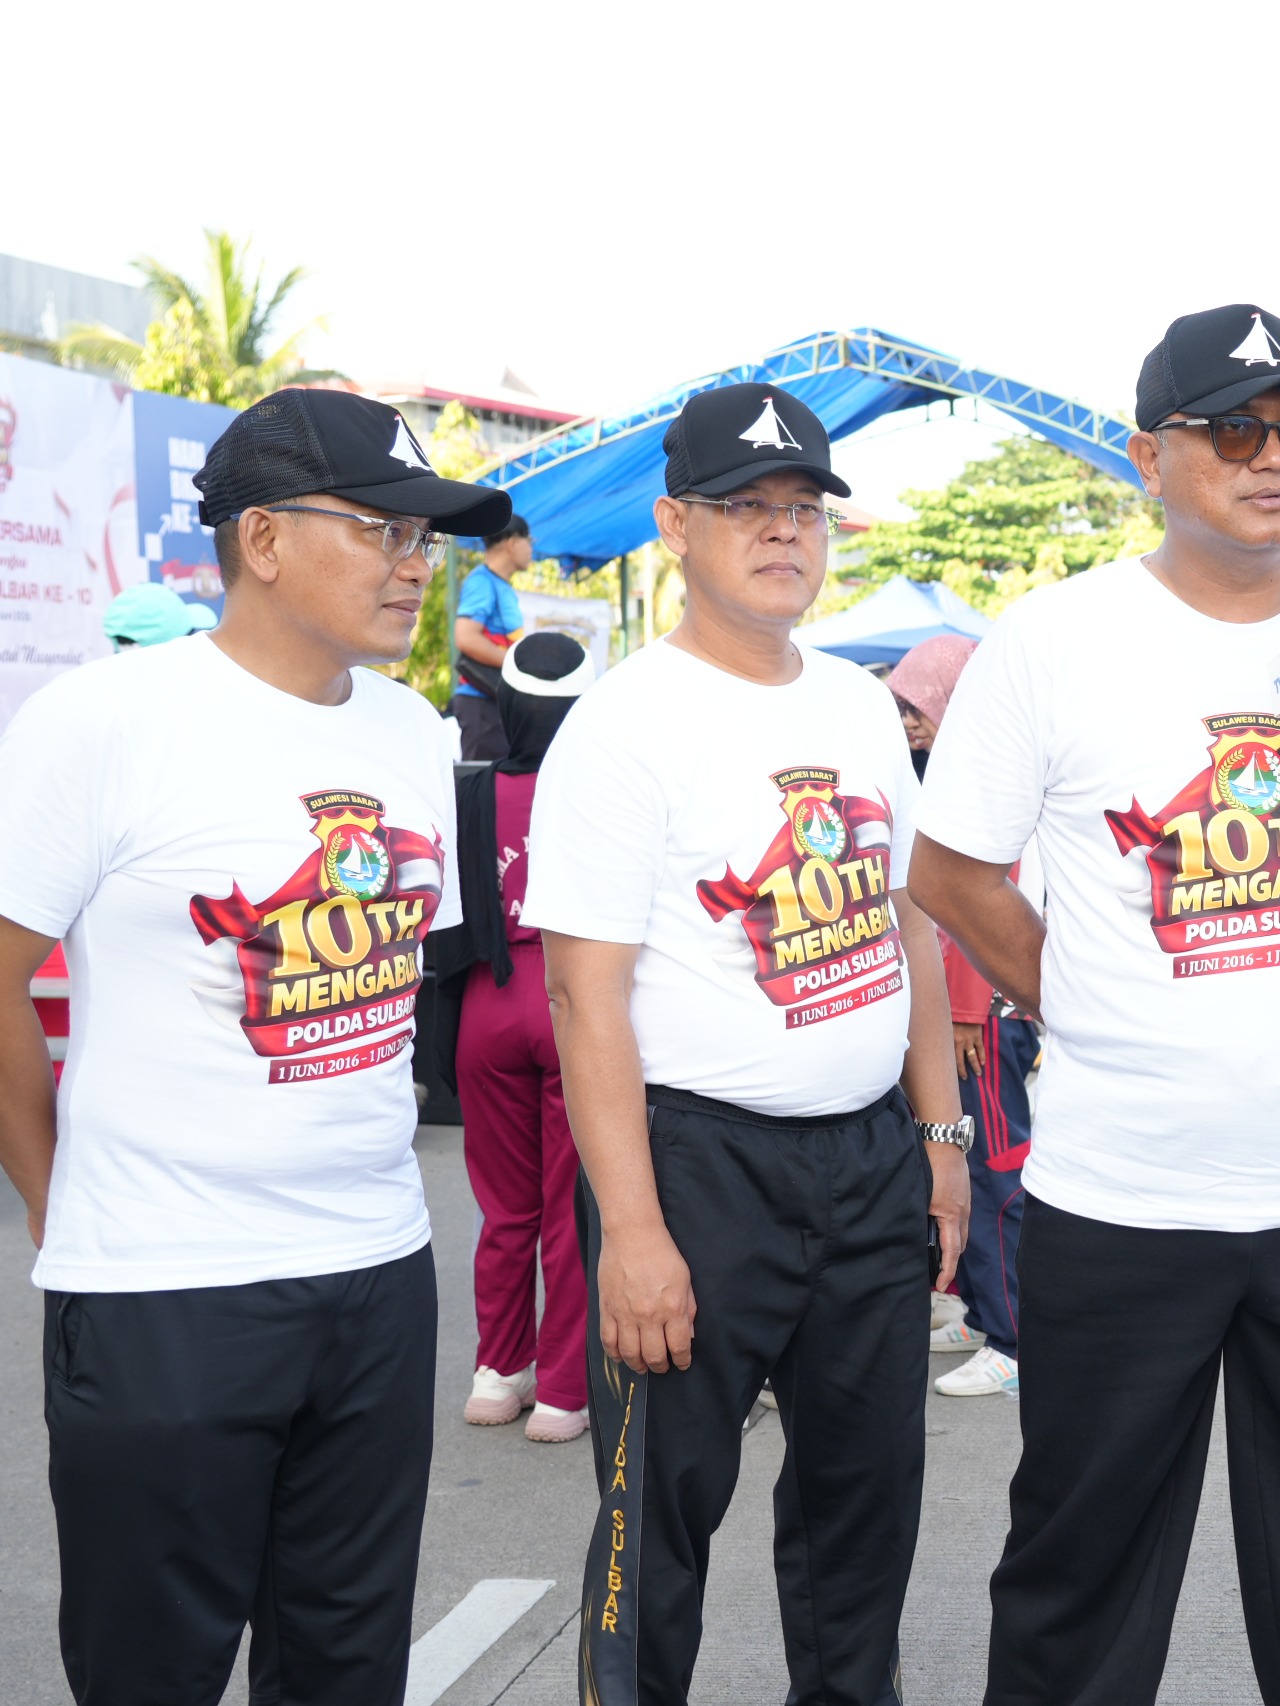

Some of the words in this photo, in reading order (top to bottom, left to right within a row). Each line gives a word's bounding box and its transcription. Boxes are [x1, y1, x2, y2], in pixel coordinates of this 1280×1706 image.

[1211, 715, 1256, 730] SULAWESI
[779, 771, 809, 785] SULAWESI
[810, 770, 833, 782] BARAT
[309, 794, 350, 810] SULAWESI
[351, 794, 378, 809] BARAT
[756, 857, 885, 936] 10TH
[259, 895, 425, 980] 10TH
[1185, 913, 1258, 944] POLDA
[793, 961, 852, 995] POLDA
[851, 940, 897, 975] SULBAR
[1180, 962, 1187, 974] 1
[1188, 957, 1219, 977] JUNI
[1222, 954, 1254, 970] 2016
[1267, 950, 1273, 963] 1
[792, 1012, 799, 1024] 1
[801, 1004, 828, 1025] JUNI
[829, 996, 854, 1014] 2016
[861, 991, 866, 1003] 1
[867, 984, 887, 1003] JUNI
[886, 975, 901, 995] 2026
[286, 1014, 364, 1048] POLDA
[278, 1067, 285, 1080] 1
[287, 1058, 325, 1080] JUNI
[327, 1052, 359, 1074] 2016
[369, 1050, 376, 1063] 1
[376, 1042, 396, 1062] JUNI
[610, 1382, 636, 1492] POLDA
[601, 1509, 625, 1634] SULBAR
